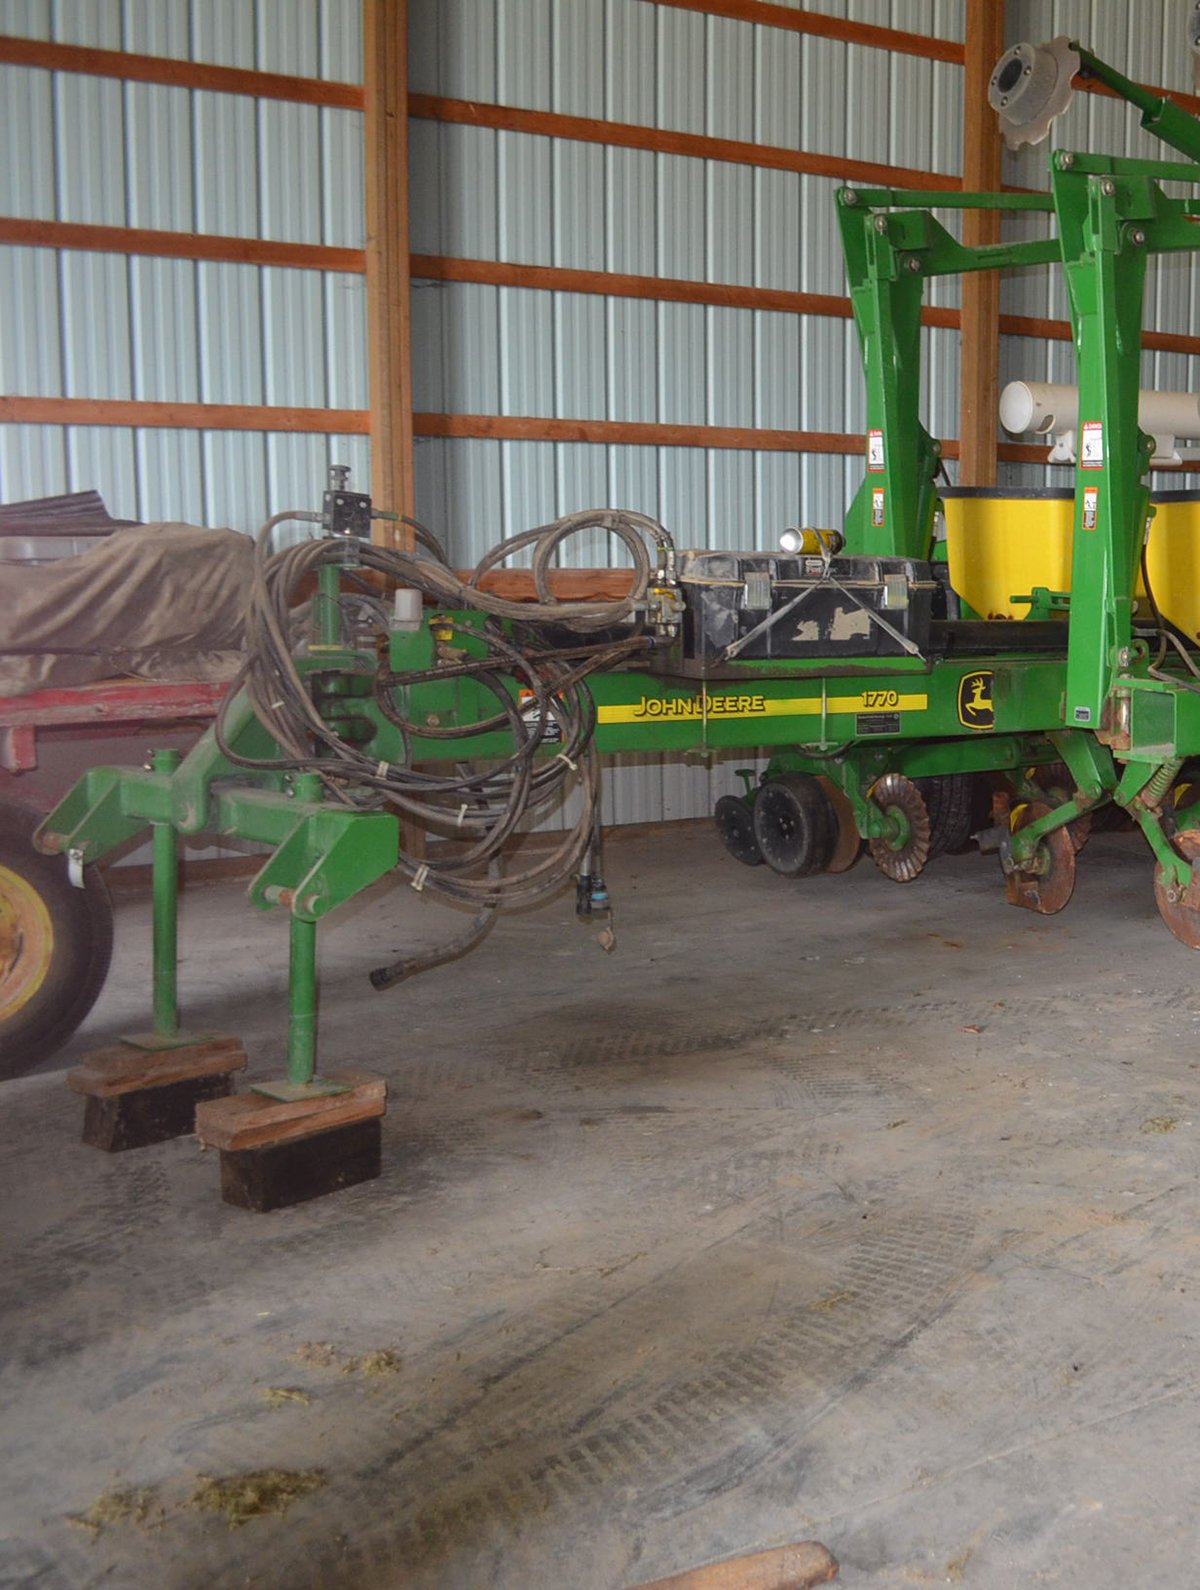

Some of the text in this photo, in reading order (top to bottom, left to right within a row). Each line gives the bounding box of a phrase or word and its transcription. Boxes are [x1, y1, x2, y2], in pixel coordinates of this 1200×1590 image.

[634, 694, 766, 717] JOHN DEERE
[861, 689, 899, 708] 1770
